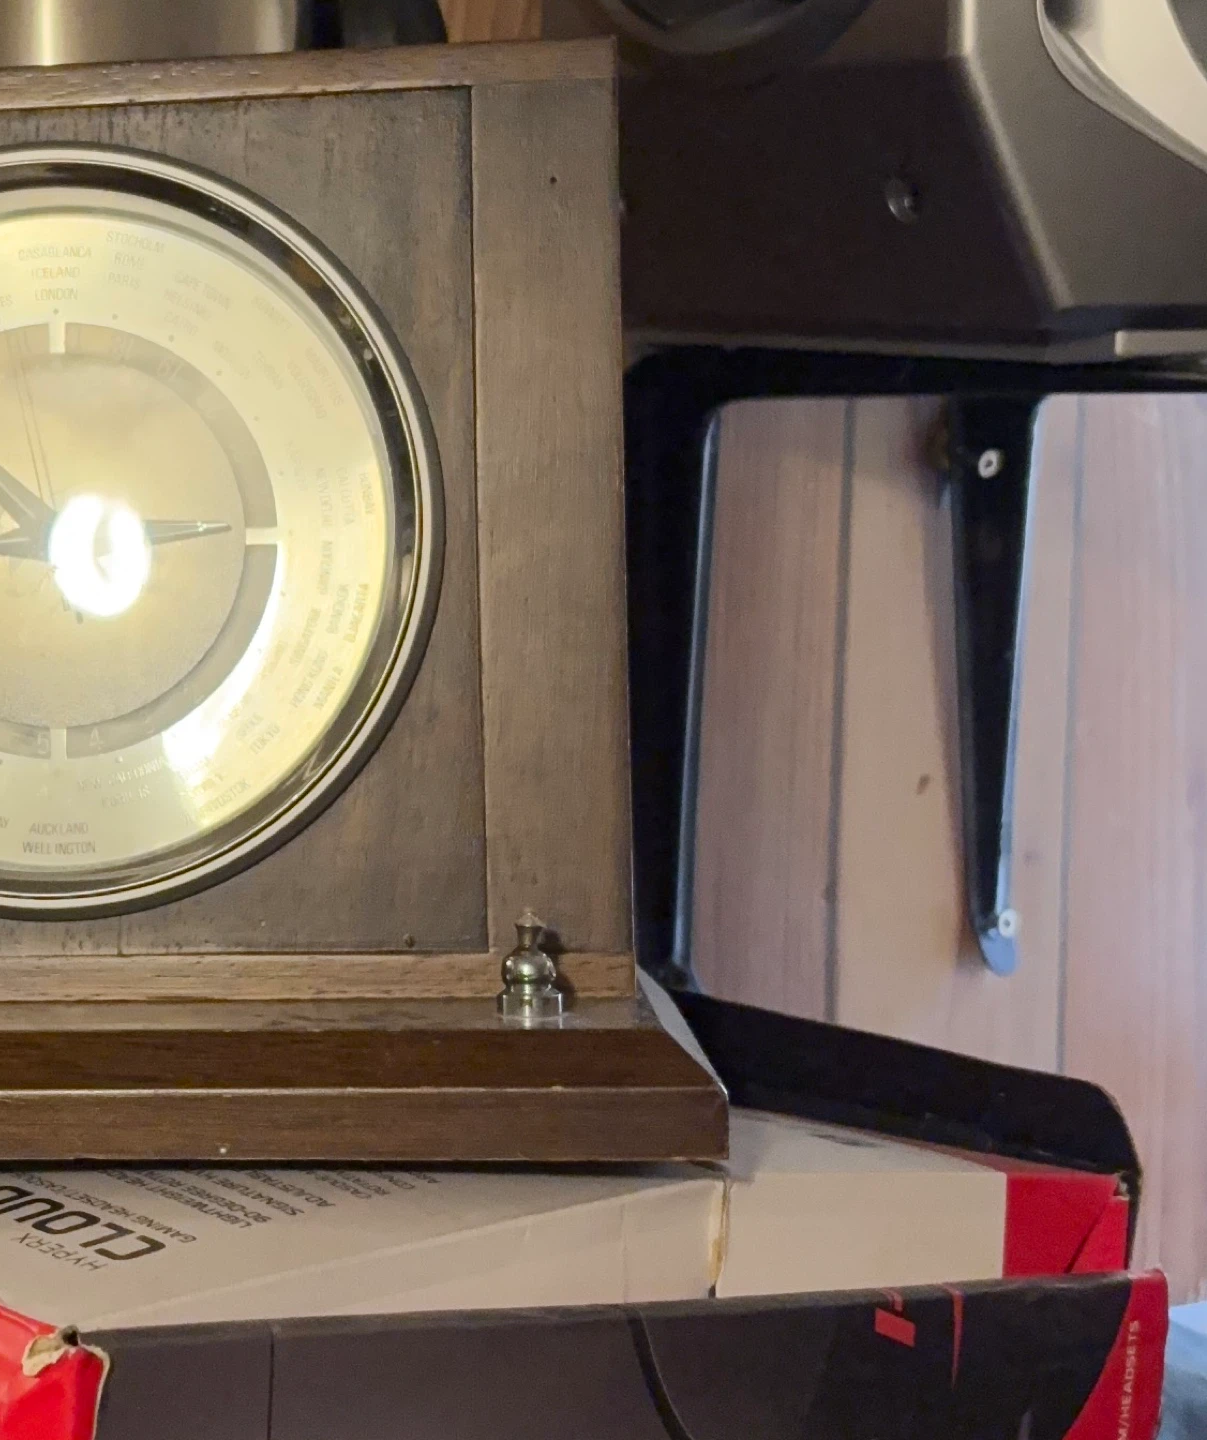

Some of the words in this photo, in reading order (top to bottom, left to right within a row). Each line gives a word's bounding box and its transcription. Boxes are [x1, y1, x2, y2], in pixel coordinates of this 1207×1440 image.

[17, 245, 92, 261] CASABLANCA
[31, 266, 80, 280] ICELAND
[34, 287, 78, 301] LONDON
[29, 822, 89, 836] AUCKLAND
[22, 839, 96, 855] WELLINGTON
[129, 1215, 197, 1244] GAMING
[10, 1232, 108, 1272] HYPERX
